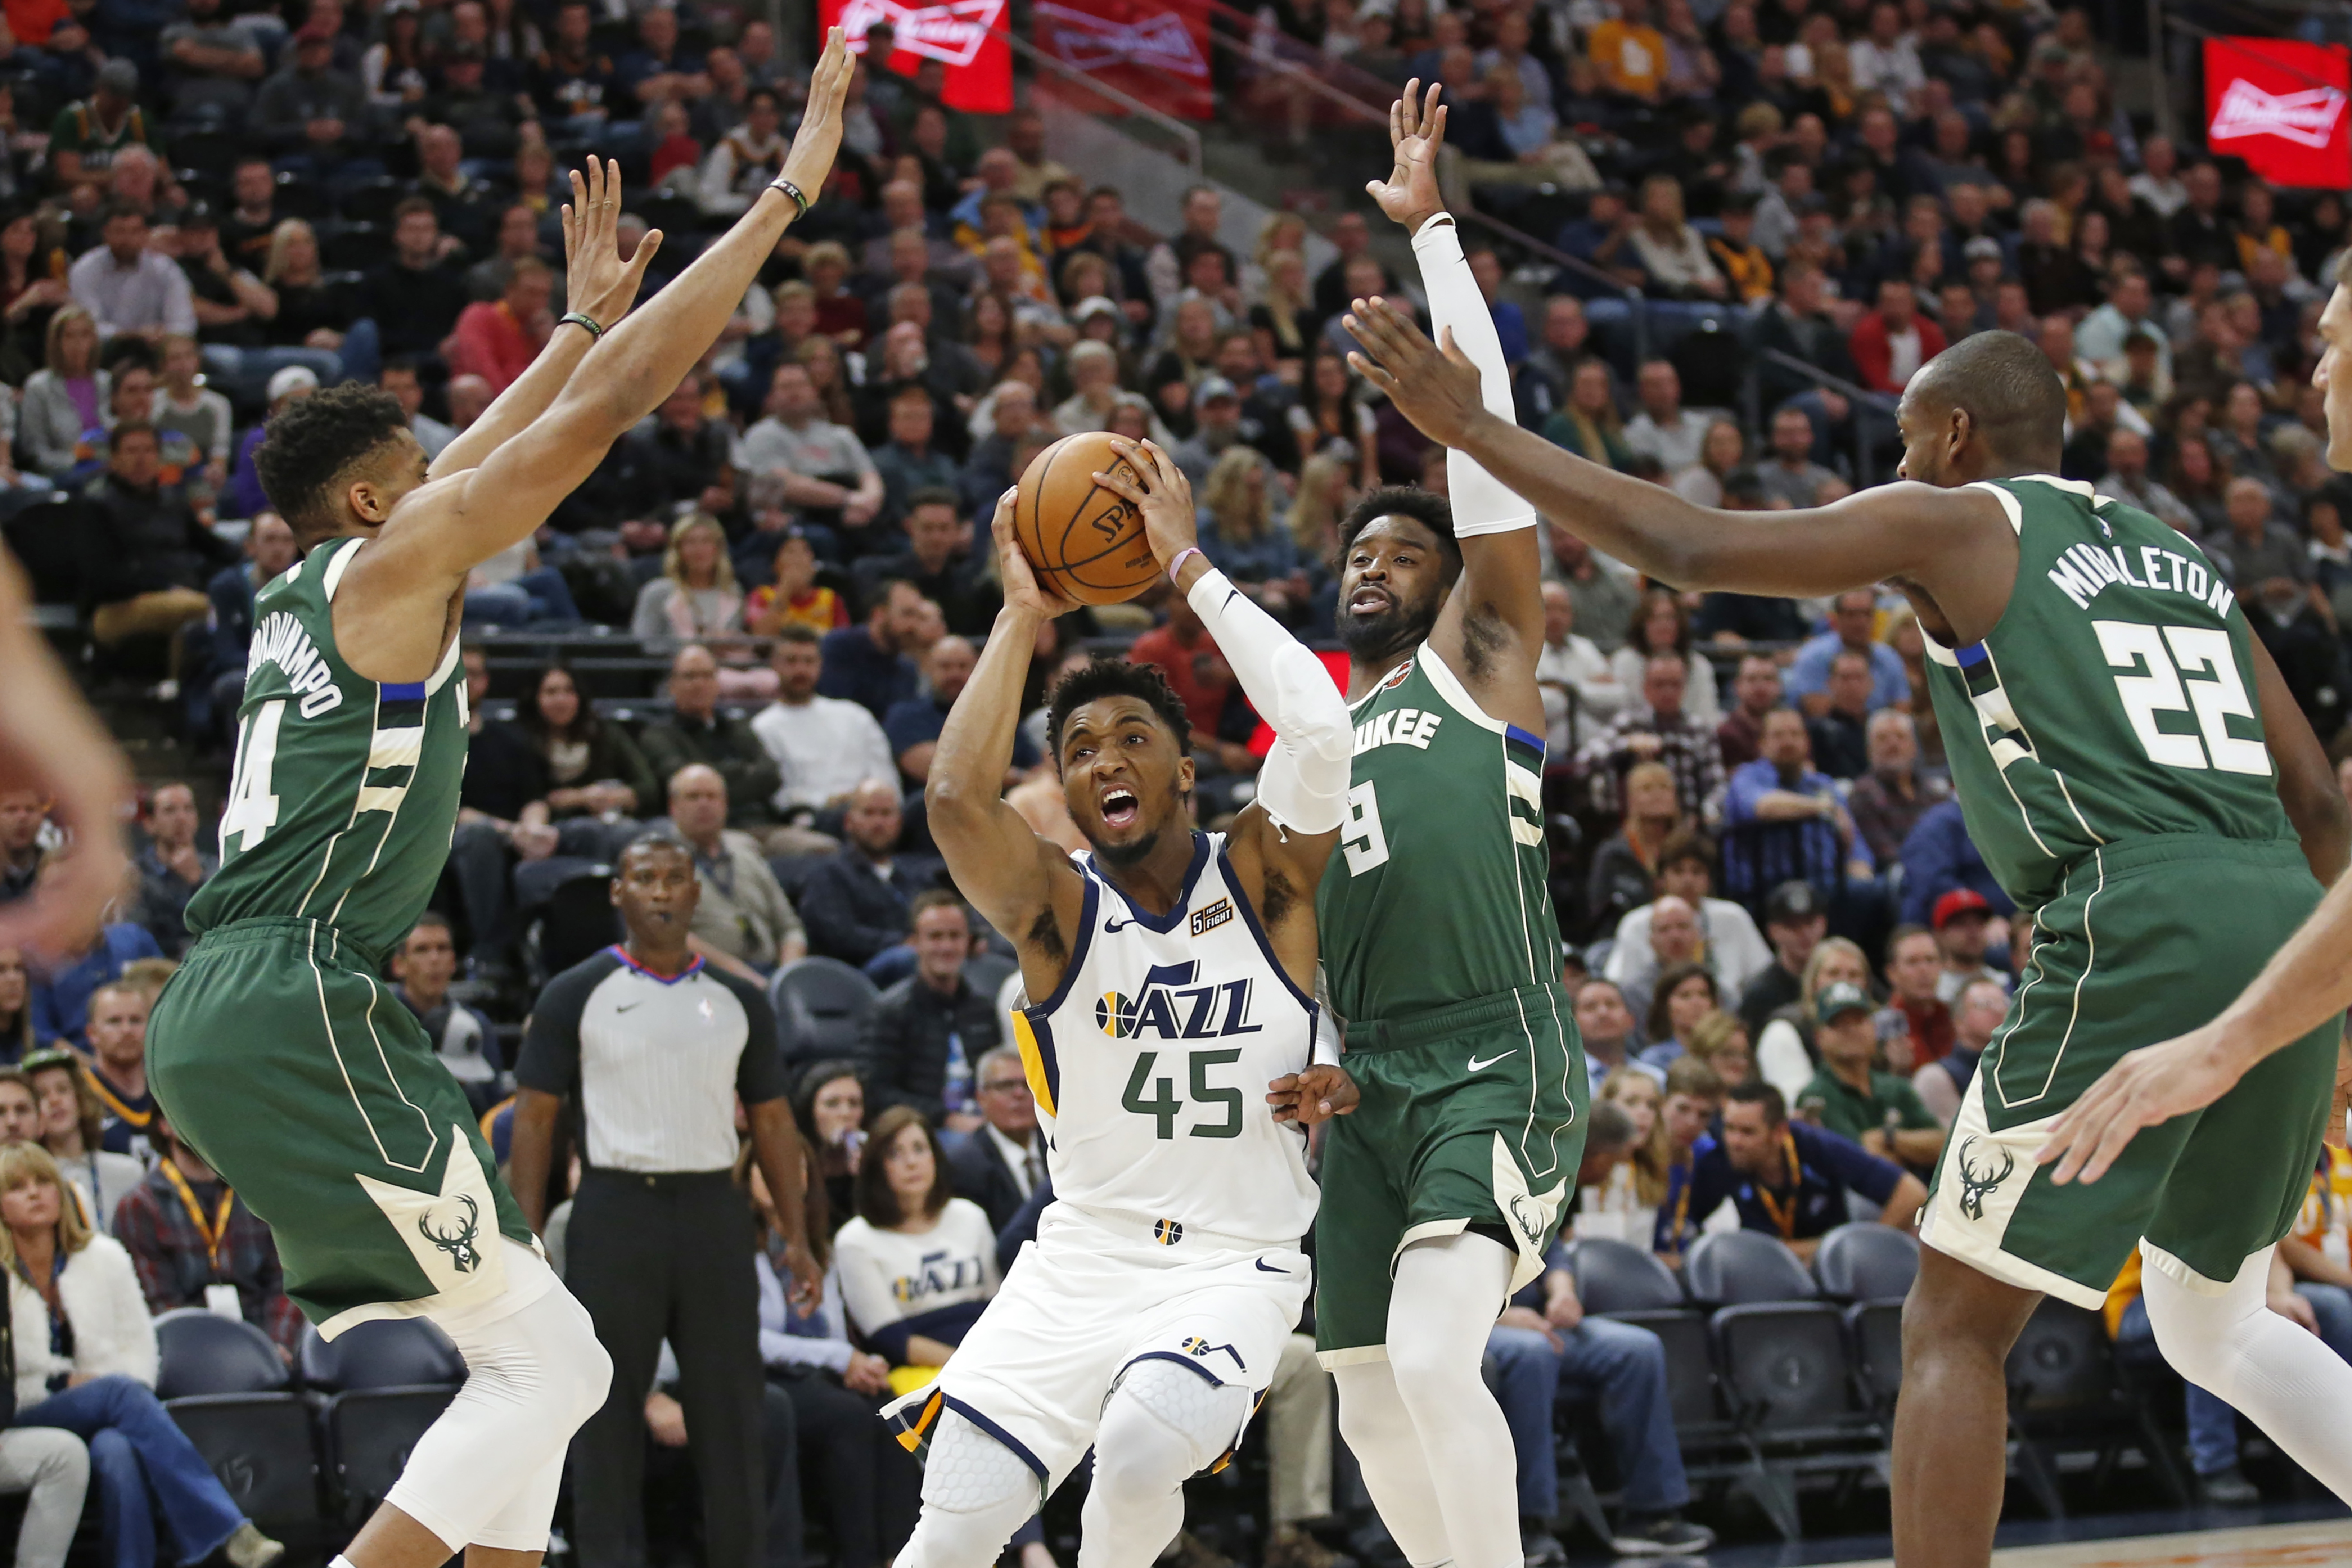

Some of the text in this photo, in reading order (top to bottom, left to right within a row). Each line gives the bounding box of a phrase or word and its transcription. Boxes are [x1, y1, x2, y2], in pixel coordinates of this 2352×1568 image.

[2047, 543, 2234, 619] MIDDLETON
[1351, 708, 1442, 757] UKEE
[2091, 620, 2272, 776] 22
[218, 699, 284, 868] 4
[1340, 780, 1389, 877] 9
[1193, 913, 1202, 934] 5
[1206, 901, 1225, 915] FOR THE
[1207, 909, 1231, 929] FIGHT
[1096, 959, 1263, 1040] JAZZ
[1122, 1048, 1242, 1139] 45
